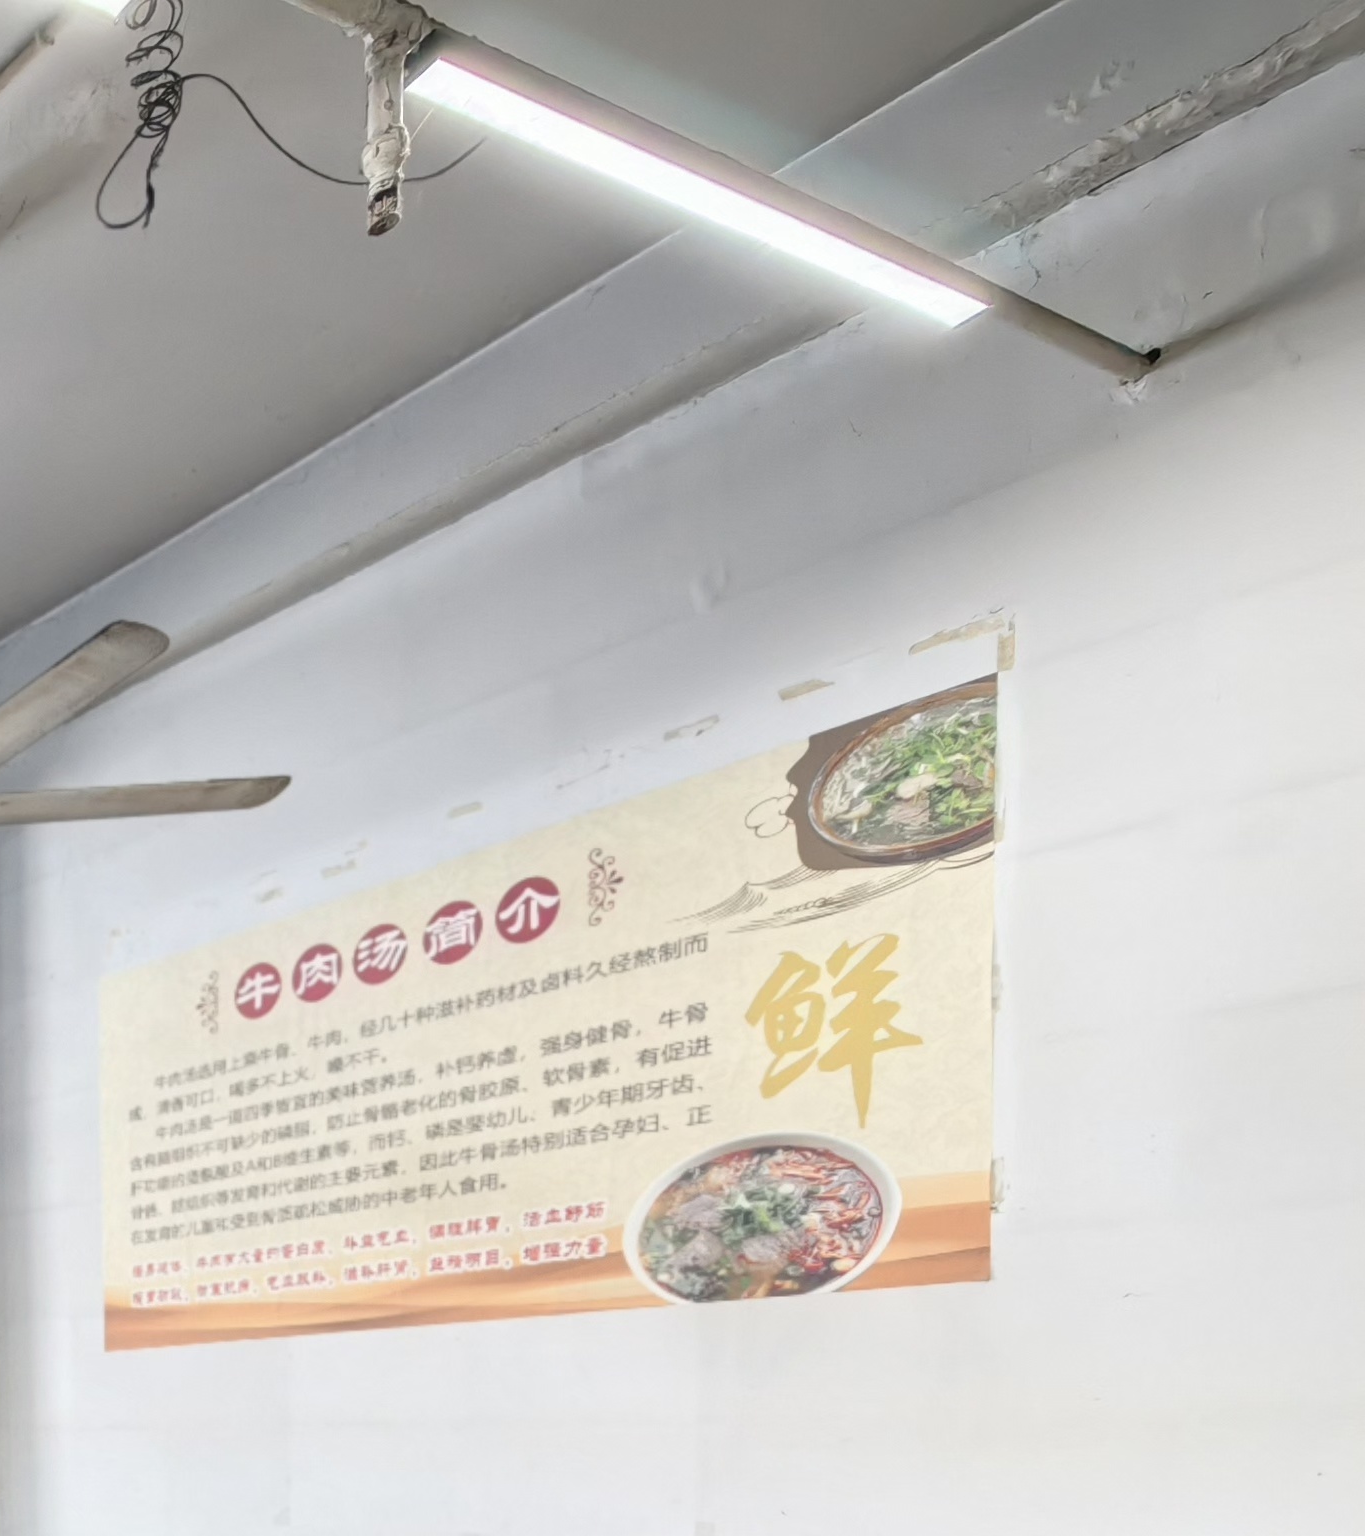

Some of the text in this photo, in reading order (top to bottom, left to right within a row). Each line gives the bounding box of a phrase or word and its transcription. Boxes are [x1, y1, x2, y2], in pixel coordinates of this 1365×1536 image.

[237, 882, 561, 1014] 牛肉汤简介
[742, 931, 924, 1129] 鲜
